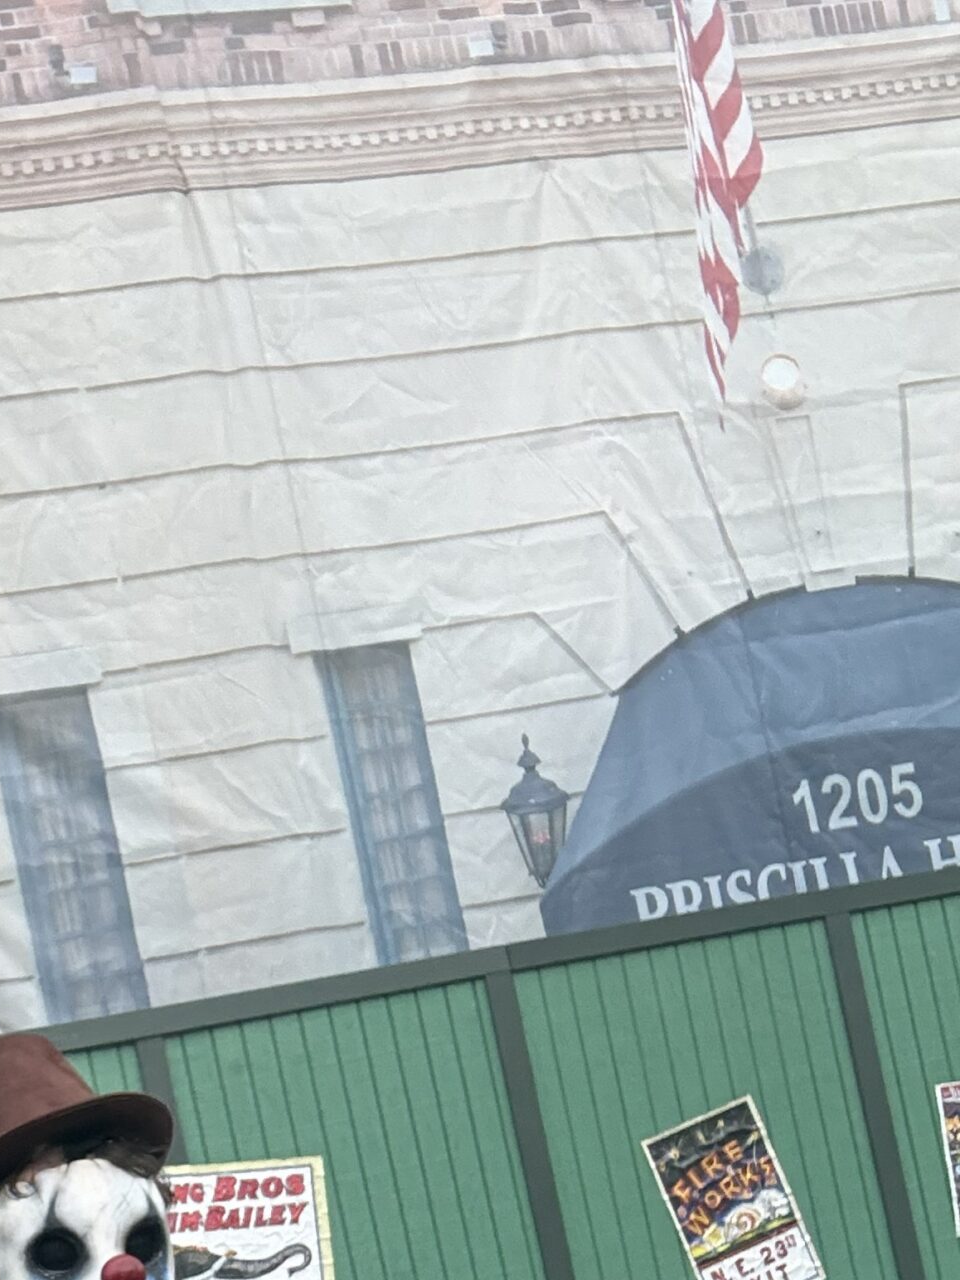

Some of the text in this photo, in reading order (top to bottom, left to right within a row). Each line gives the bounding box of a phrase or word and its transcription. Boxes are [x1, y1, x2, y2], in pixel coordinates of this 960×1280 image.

[792, 762, 923, 834] 1205
[630, 845, 903, 922] PRISCILLA
[212, 1174, 306, 1203] BROS
[671, 1139, 743, 1203] FIRE
[687, 1155, 777, 1236] WORKS
[735, 1258, 755, 1277] E.
